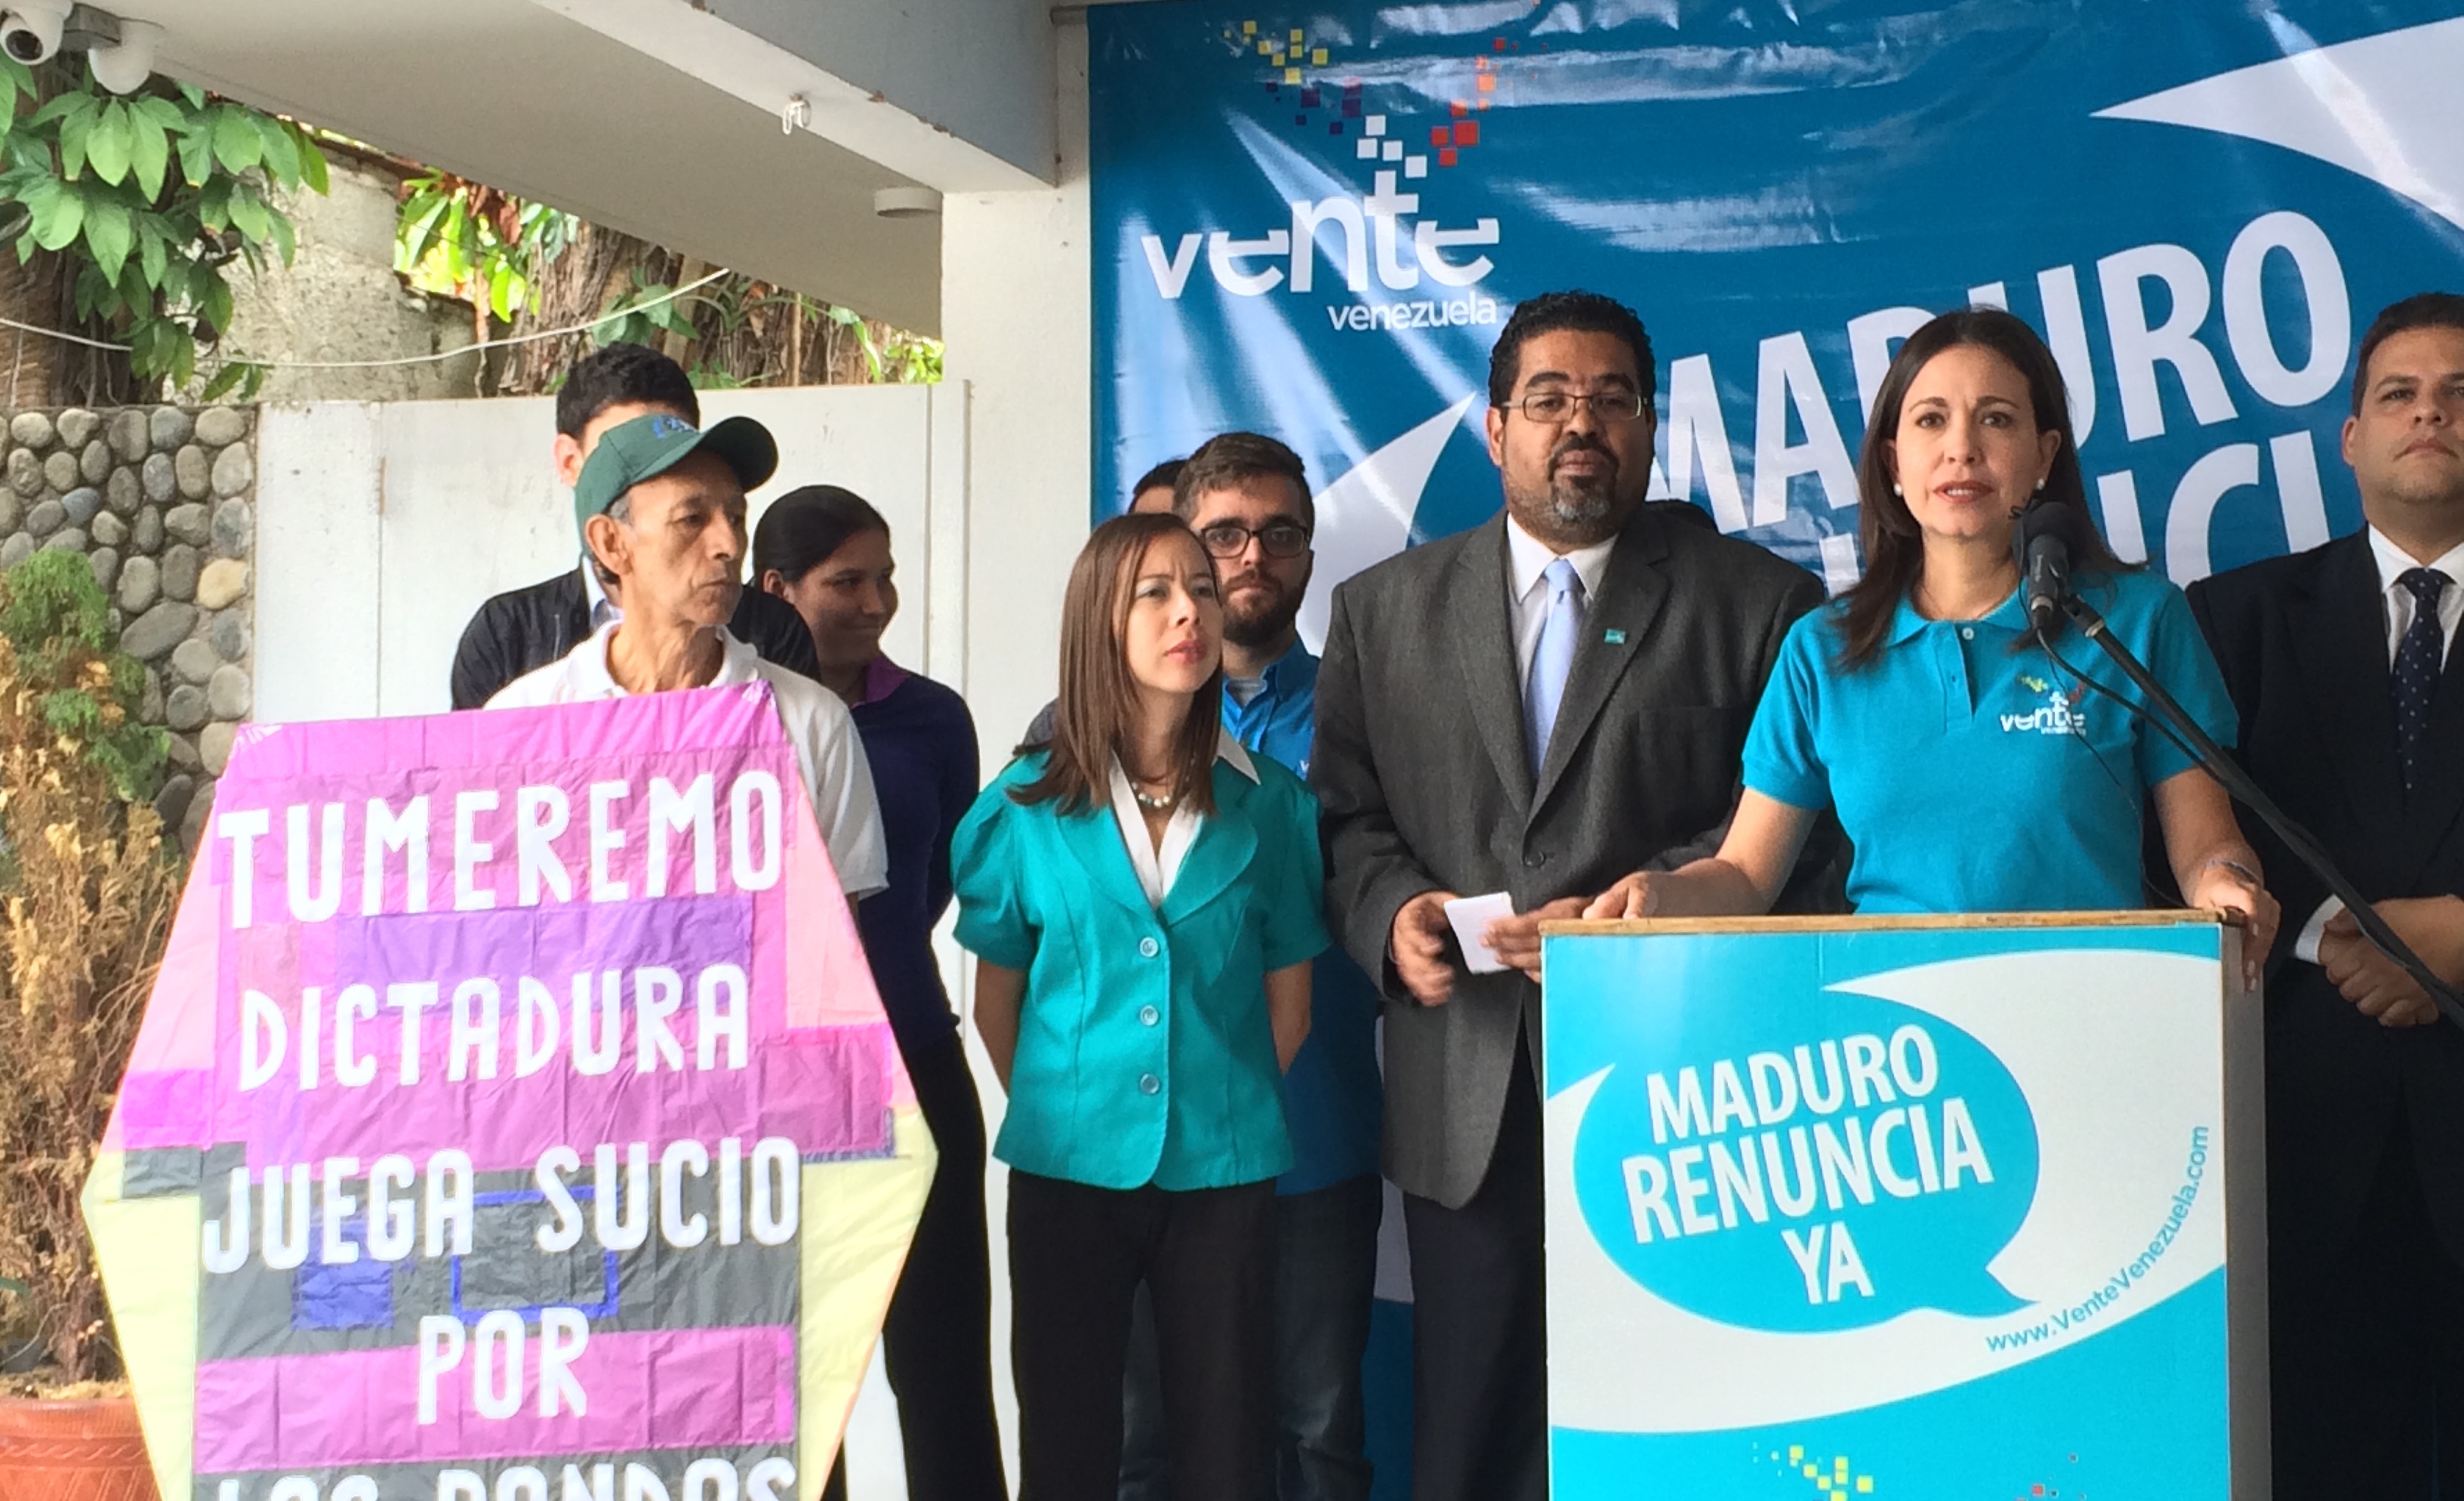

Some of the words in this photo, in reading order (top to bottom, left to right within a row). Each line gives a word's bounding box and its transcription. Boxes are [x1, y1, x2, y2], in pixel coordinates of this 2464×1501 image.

[1141, 170, 1499, 299] vente
[1327, 292, 1497, 331] venezuela
[218, 770, 783, 929] TUMEREMO
[238, 963, 749, 1091] DICTADURA
[1646, 1025, 1938, 1144] MADURO
[202, 1148, 474, 1274] JUEGA
[535, 1136, 802, 1253] SUCIO
[1622, 1098, 1994, 1244] RENUNCIA
[1780, 1220, 1875, 1305] YA
[1986, 1126, 2209, 1351] www.VenteVenezuela.com
[417, 1307, 589, 1425] POR
